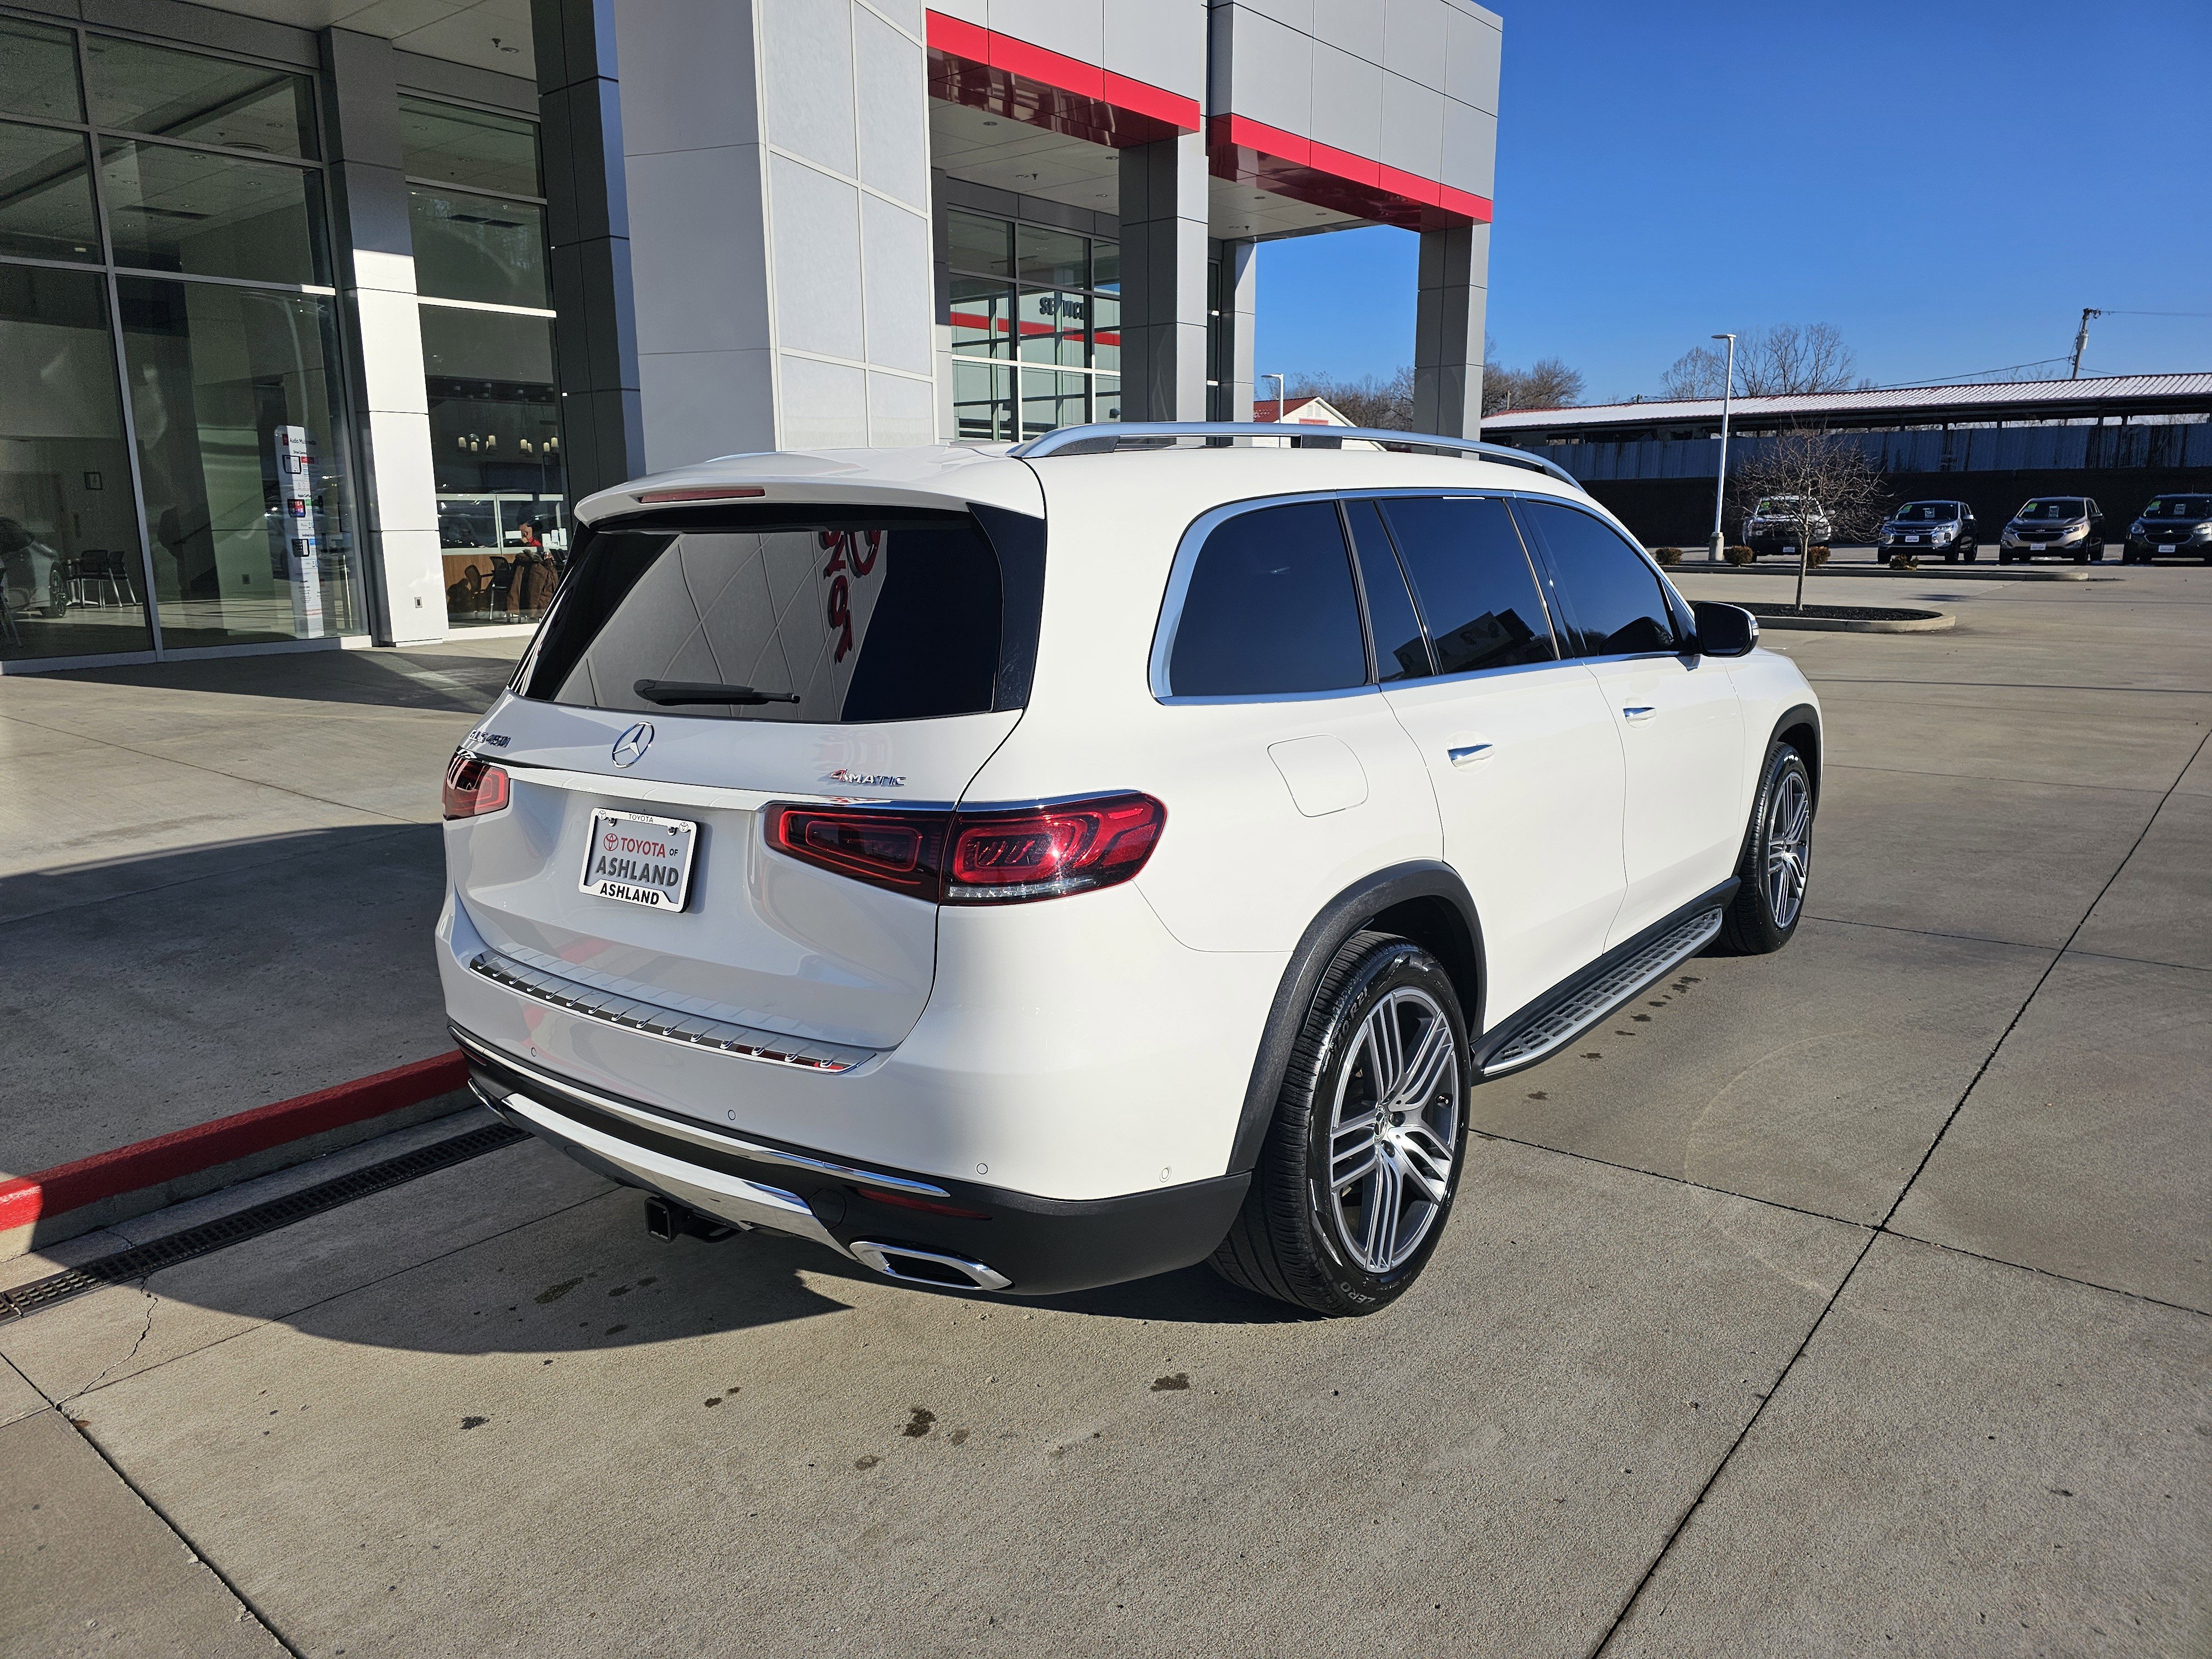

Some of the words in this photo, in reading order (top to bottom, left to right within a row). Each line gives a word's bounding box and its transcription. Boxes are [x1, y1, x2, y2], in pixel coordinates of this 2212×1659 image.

[830, 769, 907, 786] 4MATIC
[628, 813, 654, 823] TOYOTA
[621, 837, 665, 858] TOYOTA
[669, 848, 679, 857] OF
[595, 855, 679, 887] ASHLAND
[600, 883, 659, 905] ASHLAND
